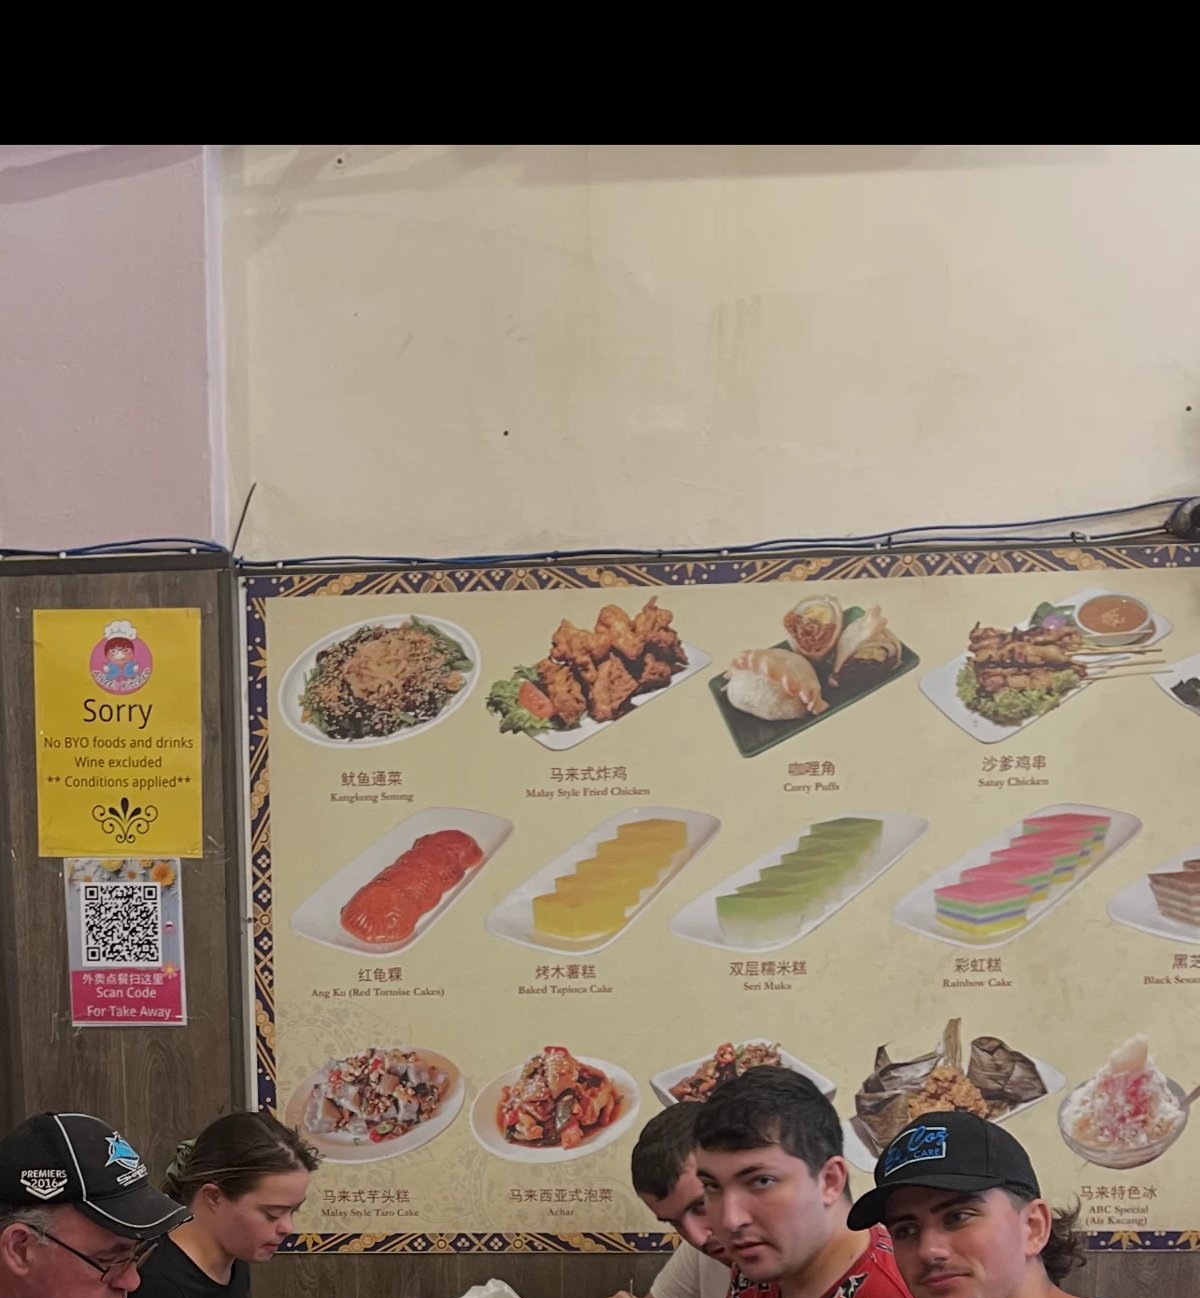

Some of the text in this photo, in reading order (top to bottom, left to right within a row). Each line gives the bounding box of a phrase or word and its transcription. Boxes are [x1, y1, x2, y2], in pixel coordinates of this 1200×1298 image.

[83, 699, 152, 730] Sorry
[44, 737, 194, 749] No BYO foods and drinks
[75, 756, 162, 768] Wine excluded
[341, 771, 402, 787] 鱿鱼通菜
[549, 765, 627, 782] 马来式炸鸡
[65, 776, 129, 787] Conditions
[784, 781, 840, 794] Curry Puffs
[978, 776, 1049, 789] Satay Chicken
[525, 786, 650, 800] Malay Style Fried Chicken
[728, 960, 807, 977] 双层糯米糕
[954, 957, 1003, 973] 彩虹糕
[358, 967, 403, 983] 红龟粿
[535, 964, 597, 980] 烤木薯糕
[82, 973, 164, 986] 外卖点餐扫这里
[743, 981, 792, 991] Seri Muka
[942, 978, 1013, 989] Rainbow Cake
[1144, 975, 1171, 985] Black
[96, 986, 157, 999] Scan Code
[311, 987, 445, 999] Ang Ku (Red Tortoise Cakes)
[518, 984, 614, 996] Baked Tapioca Cake
[87, 1005, 171, 1020] For Take Away
[914, 1148, 941, 1158] CARE
[21, 1169, 67, 1179] PREMIERS
[31, 1179, 59, 1188] 2016
[323, 1189, 410, 1204] 马来式芋头糕
[509, 1188, 614, 1203] 马来西亚式泡菜
[1080, 1185, 1158, 1200] 马来特色冰
[321, 1208, 420, 1219] Malay Style Taro Cake
[548, 1207, 575, 1217] Achar
[1089, 1205, 1149, 1216] ABC Special
[1085, 1216, 1148, 1227] (Air Kacang)
